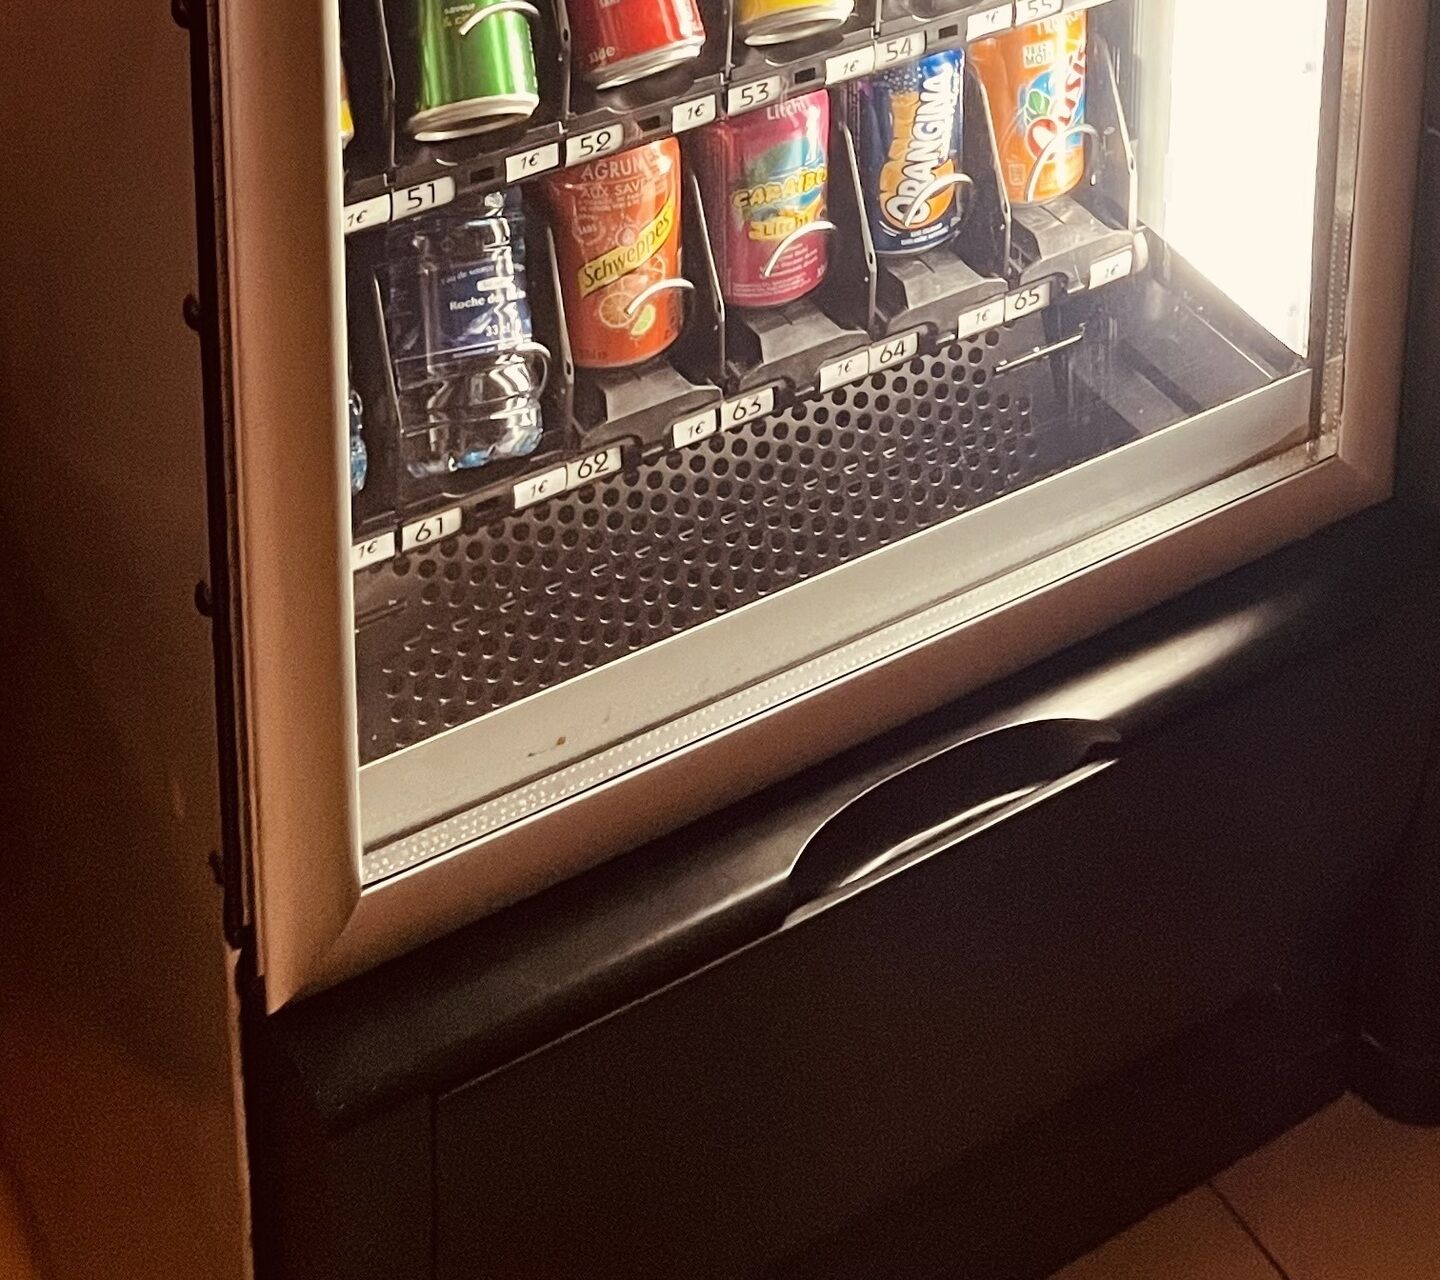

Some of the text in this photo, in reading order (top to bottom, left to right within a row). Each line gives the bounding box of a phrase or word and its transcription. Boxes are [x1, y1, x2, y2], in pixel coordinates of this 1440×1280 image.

[347, 210, 368, 226] 1€
[406, 183, 436, 211] 51
[519, 152, 540, 169] 1€
[579, 132, 612, 156] 52
[687, 102, 707, 120] 1€
[740, 82, 769, 109] 53
[842, 60, 859, 75] 1€
[886, 39, 914, 64] 54
[885, 62, 954, 226] ORANGINA
[583, 213, 671, 289] Schweppes
[357, 263, 1120, 556] 1€ 61 1€ 62 1€ 63 1€ 64 1€ 65 1€
